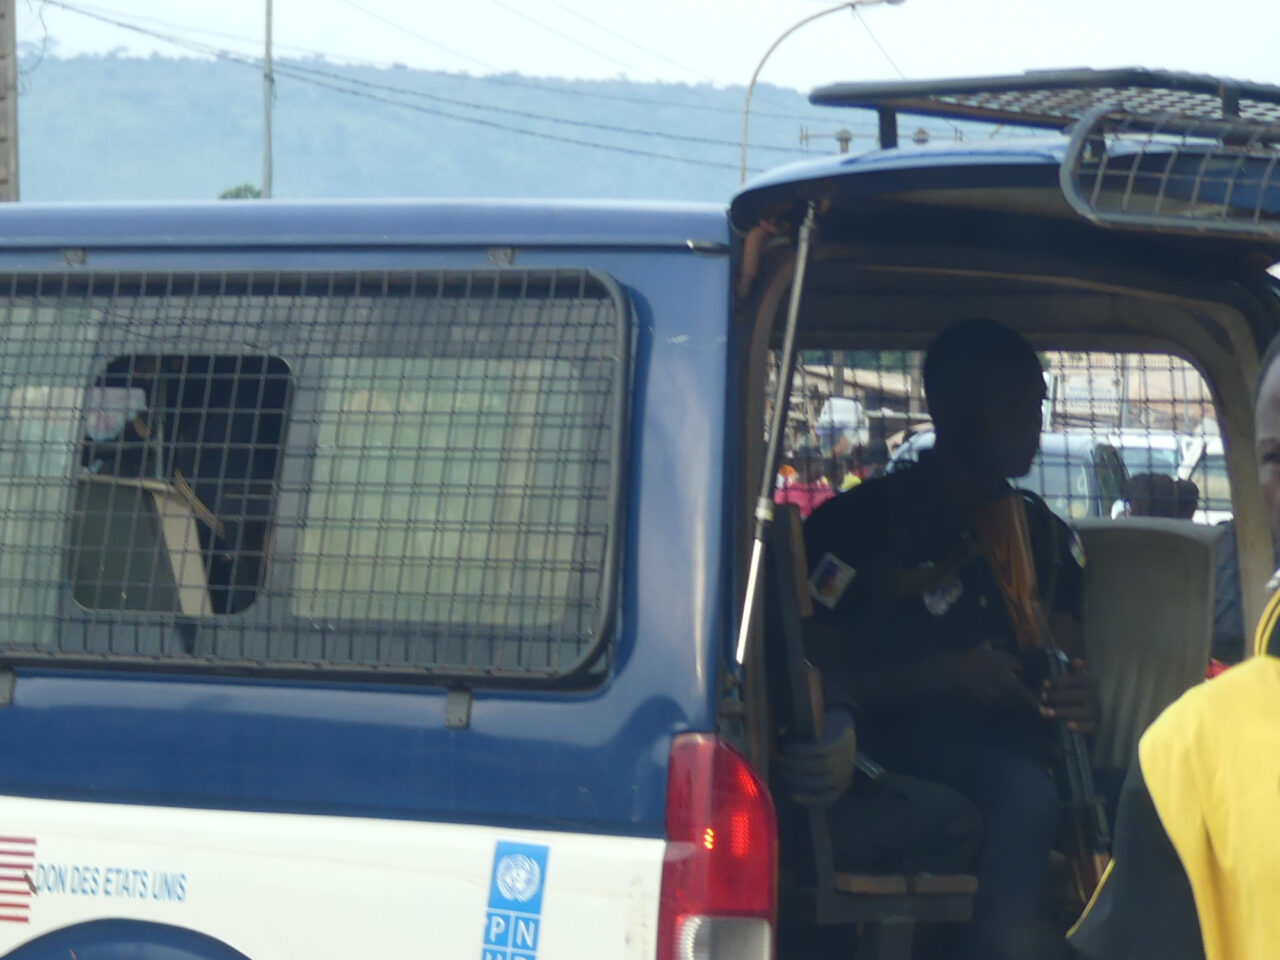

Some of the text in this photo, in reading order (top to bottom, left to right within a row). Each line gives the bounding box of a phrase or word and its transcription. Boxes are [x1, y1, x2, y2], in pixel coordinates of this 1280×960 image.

[35, 863, 187, 902] DON DES ETATS UNIS
